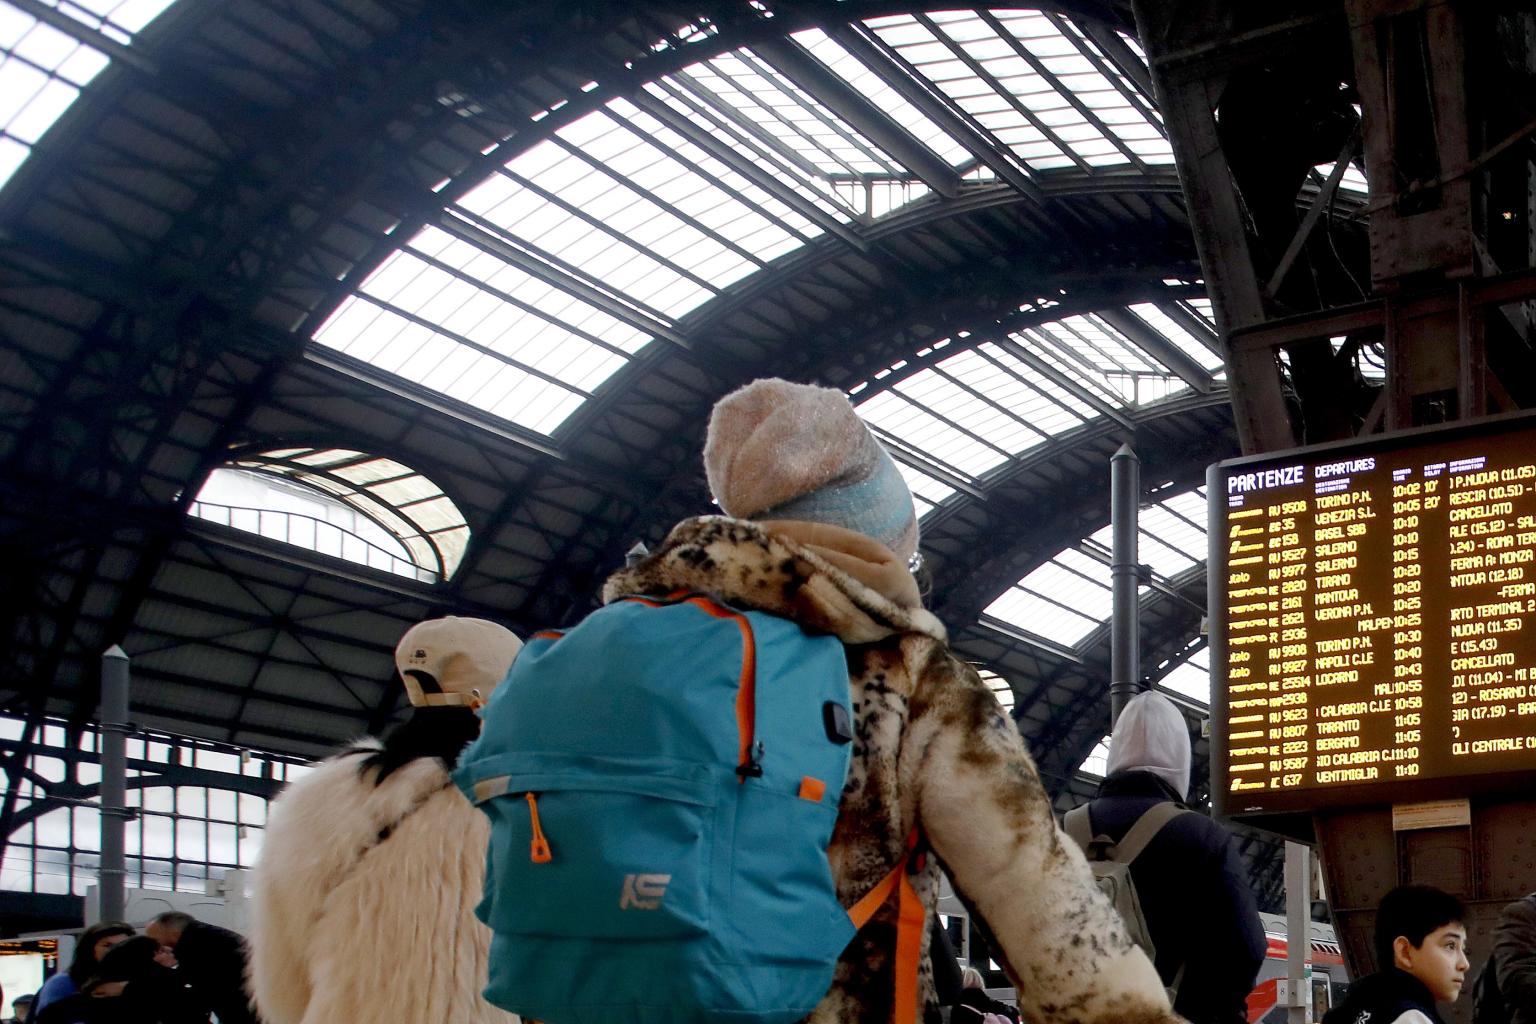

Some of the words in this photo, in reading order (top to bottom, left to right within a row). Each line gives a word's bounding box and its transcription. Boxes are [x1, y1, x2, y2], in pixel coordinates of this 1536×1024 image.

[1228, 466, 1304, 493] PARTENZE
[1315, 458, 1375, 477] DEPARTURES
[1282, 501, 1307, 515] 9508
[1315, 494, 1351, 509] TORINO
[1352, 491, 1372, 504] P.N.
[1393, 483, 1421, 498] 10:02
[1456, 471, 1499, 489] P.NUOVA
[1501, 465, 1536, 481] (11.05)
[1282, 518, 1296, 531] 35
[1315, 509, 1356, 526] VENEZIA
[1358, 506, 1377, 519] S.L.
[1393, 499, 1421, 514] 10:05
[1489, 484, 1524, 500] (10.51)
[1282, 533, 1299, 547] 158
[1315, 527, 1346, 542] BASEL
[1347, 523, 1367, 537] SBB
[1393, 516, 1419, 530] 10:10
[1450, 502, 1513, 522] CANCELLATO
[1282, 548, 1307, 562] 9527
[1315, 541, 1357, 557] SALERNO
[1393, 532, 1419, 547] 10:10
[1471, 520, 1506, 535] (15.12)
[1282, 564, 1307, 578] 9977
[1315, 557, 1357, 573] SALERNO
[1393, 548, 1419, 563] 10:15
[1487, 535, 1514, 550] ROMA
[1282, 580, 1307, 594] 2820
[1315, 574, 1351, 589] TIRANO
[1393, 564, 1421, 579] 10:20
[1451, 556, 1484, 571] FERMA
[1500, 549, 1534, 565] MONZA
[1282, 596, 1303, 610] 2161
[1315, 589, 1359, 605] MANTOVA
[1393, 580, 1421, 595] 10:20
[1489, 568, 1524, 583] (12.18)
[1282, 612, 1305, 626] 2621
[1315, 606, 1352, 621] VERONA
[1354, 603, 1374, 617] P.N.
[1394, 597, 1422, 612] 10:25
[1282, 628, 1307, 642] 2936
[1394, 613, 1422, 628] 10:25
[1476, 601, 1526, 618] TERMINAL
[1282, 644, 1308, 658] 9908
[1316, 638, 1352, 653] TORINO
[1353, 636, 1373, 649] P.N.
[1394, 630, 1422, 645] 10:30
[1452, 623, 1485, 638] NUOVA
[1487, 618, 1522, 634] (11.35)
[1282, 660, 1308, 674] 9927
[1315, 655, 1350, 670] NAPOLI
[1352, 652, 1374, 666] C.LE
[1394, 647, 1422, 661] 10:40
[1461, 638, 1498, 654] (15.43)
[1282, 676, 1311, 690] 25514
[1316, 670, 1359, 686] LOCARNO
[1395, 663, 1423, 678] 10:43
[1451, 653, 1515, 671] CANCELLATO
[1282, 692, 1308, 706] 2938
[1394, 680, 1423, 694] 10:55
[1469, 671, 1504, 686] (11.04)
[1515, 669, 1527, 681] MI
[1283, 708, 1308, 722] 9623
[1321, 702, 1368, 718] CALABRIA
[1370, 699, 1392, 713] C.LE
[1395, 696, 1423, 711] 10:58
[1480, 686, 1527, 702] ROSARNO
[1283, 725, 1308, 738] 8807
[1317, 719, 1360, 735] TARANTO
[1395, 713, 1421, 727] 11:05
[1472, 705, 1506, 720] (17.19)
[1283, 741, 1308, 754] 2223
[1316, 736, 1360, 751] BERGAMO
[1395, 730, 1421, 744] 11:05
[1283, 757, 1308, 770] 9587
[1333, 750, 1381, 766] CALABRIA
[1395, 747, 1419, 761] 11:10
[1472, 737, 1524, 754] CENTRALE
[1283, 774, 1303, 787] 637
[1395, 764, 1419, 777] 11:10
[1280, 987, 1285, 996] 8
